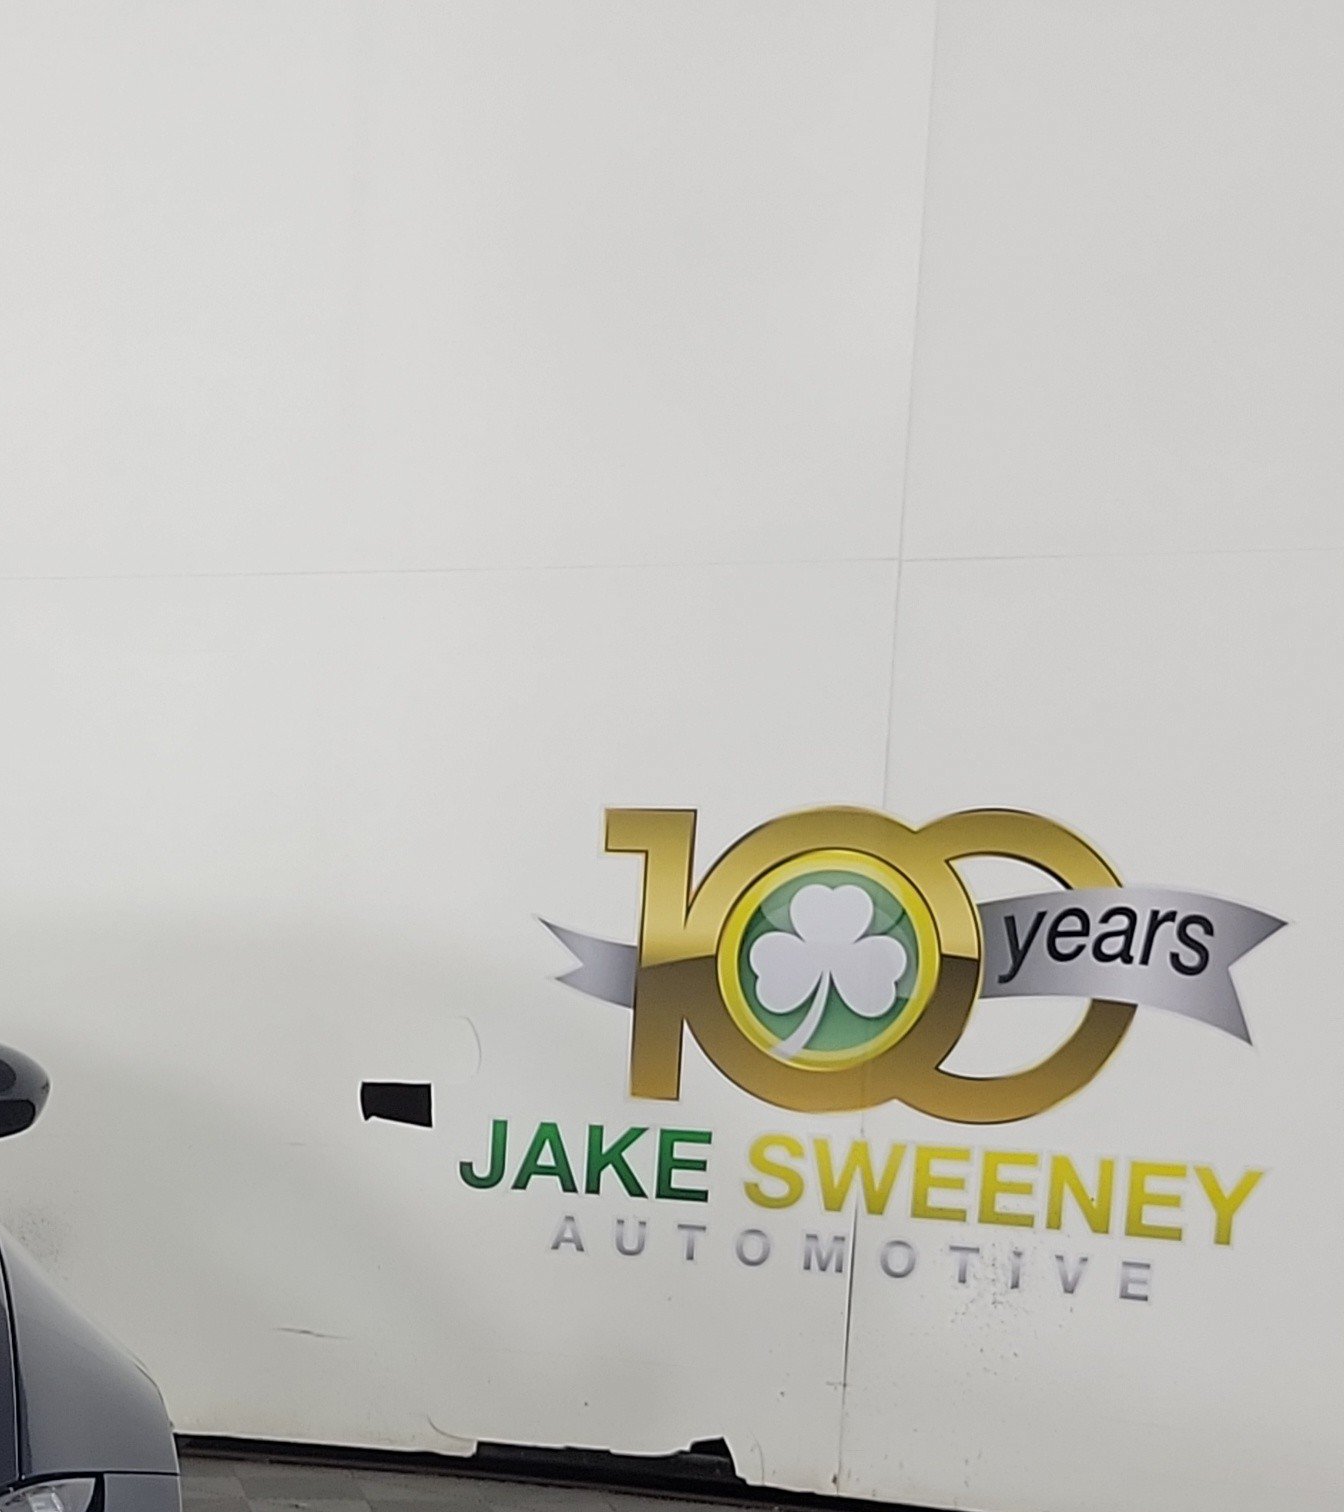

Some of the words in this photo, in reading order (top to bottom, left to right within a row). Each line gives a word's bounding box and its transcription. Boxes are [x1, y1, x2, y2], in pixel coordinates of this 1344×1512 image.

[604, 806, 1138, 1125] 100
[997, 906, 1215, 982] years
[458, 1118, 713, 1203] JAKE
[743, 1133, 1265, 1247] SWEENEY
[550, 1215, 1152, 1302] AUTOMOTIVE
